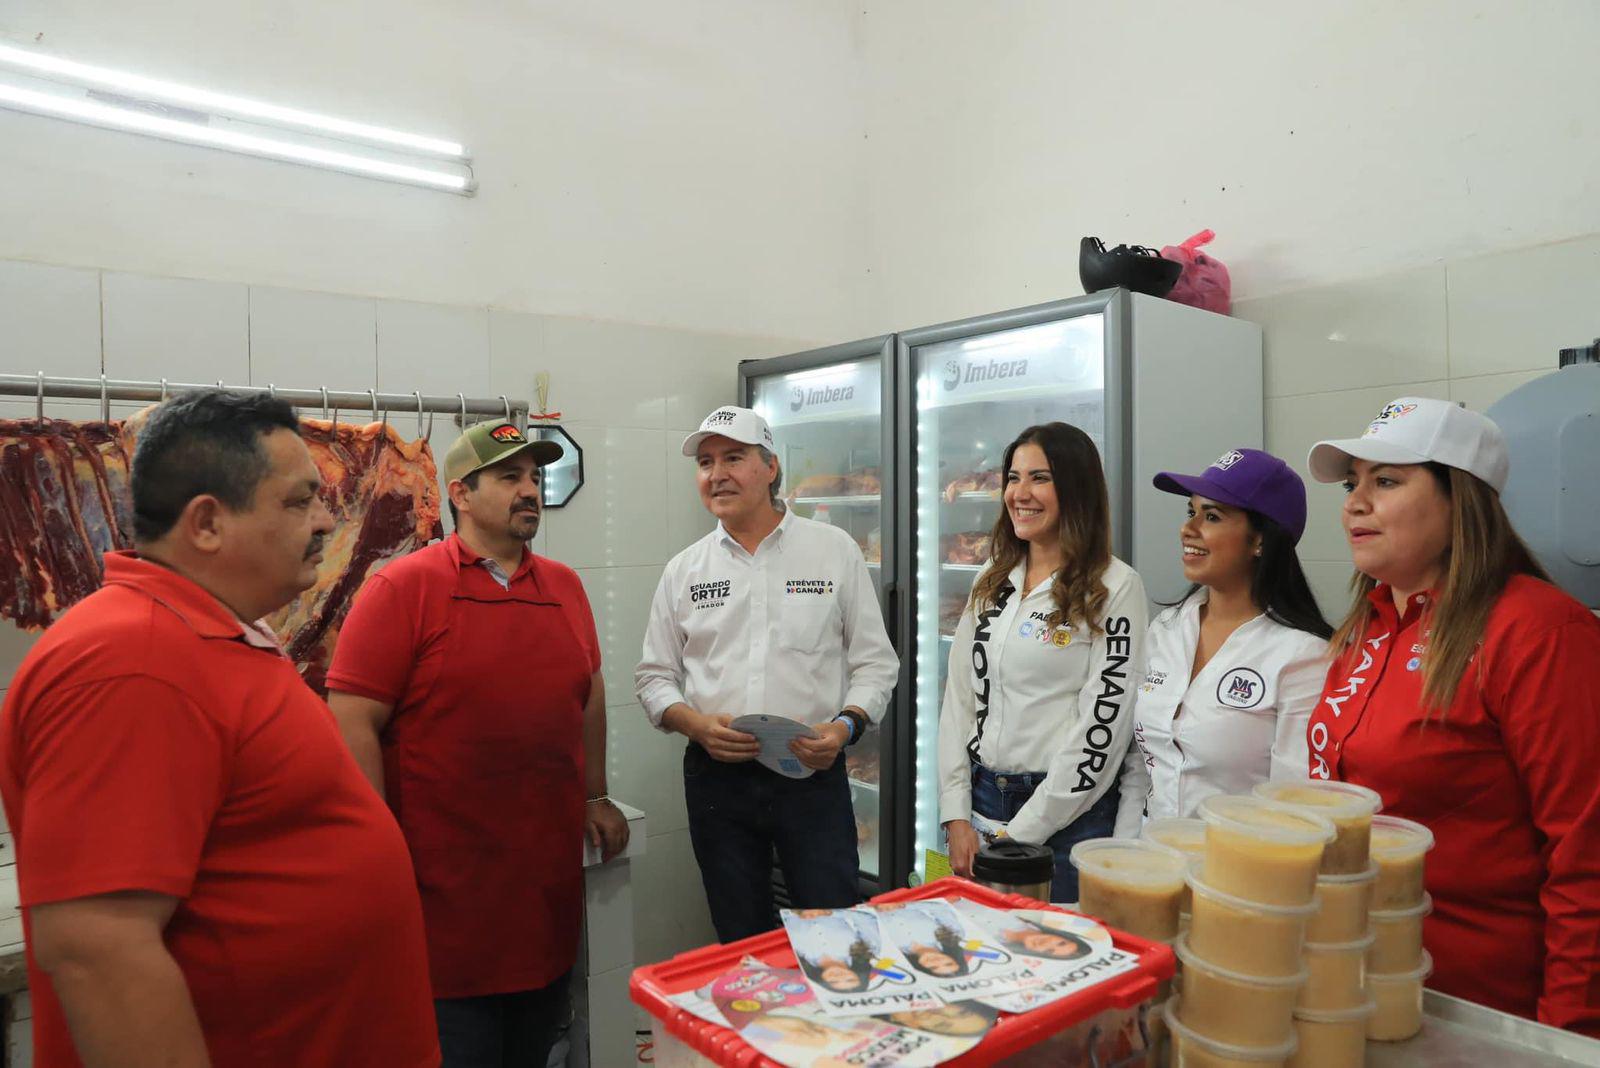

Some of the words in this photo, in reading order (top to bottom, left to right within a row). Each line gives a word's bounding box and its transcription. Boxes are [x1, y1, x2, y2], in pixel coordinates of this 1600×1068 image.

[964, 359, 1028, 384] Imbera
[806, 385, 854, 406] Imbera
[690, 579, 731, 592] EDUARDO
[691, 586, 731, 603] ORTIZ
[1070, 616, 1131, 793] SENADORA
[938, 967, 1035, 993] PALOMA
[1041, 952, 1126, 993] PALOMA
[828, 992, 932, 1008] PALOMA
